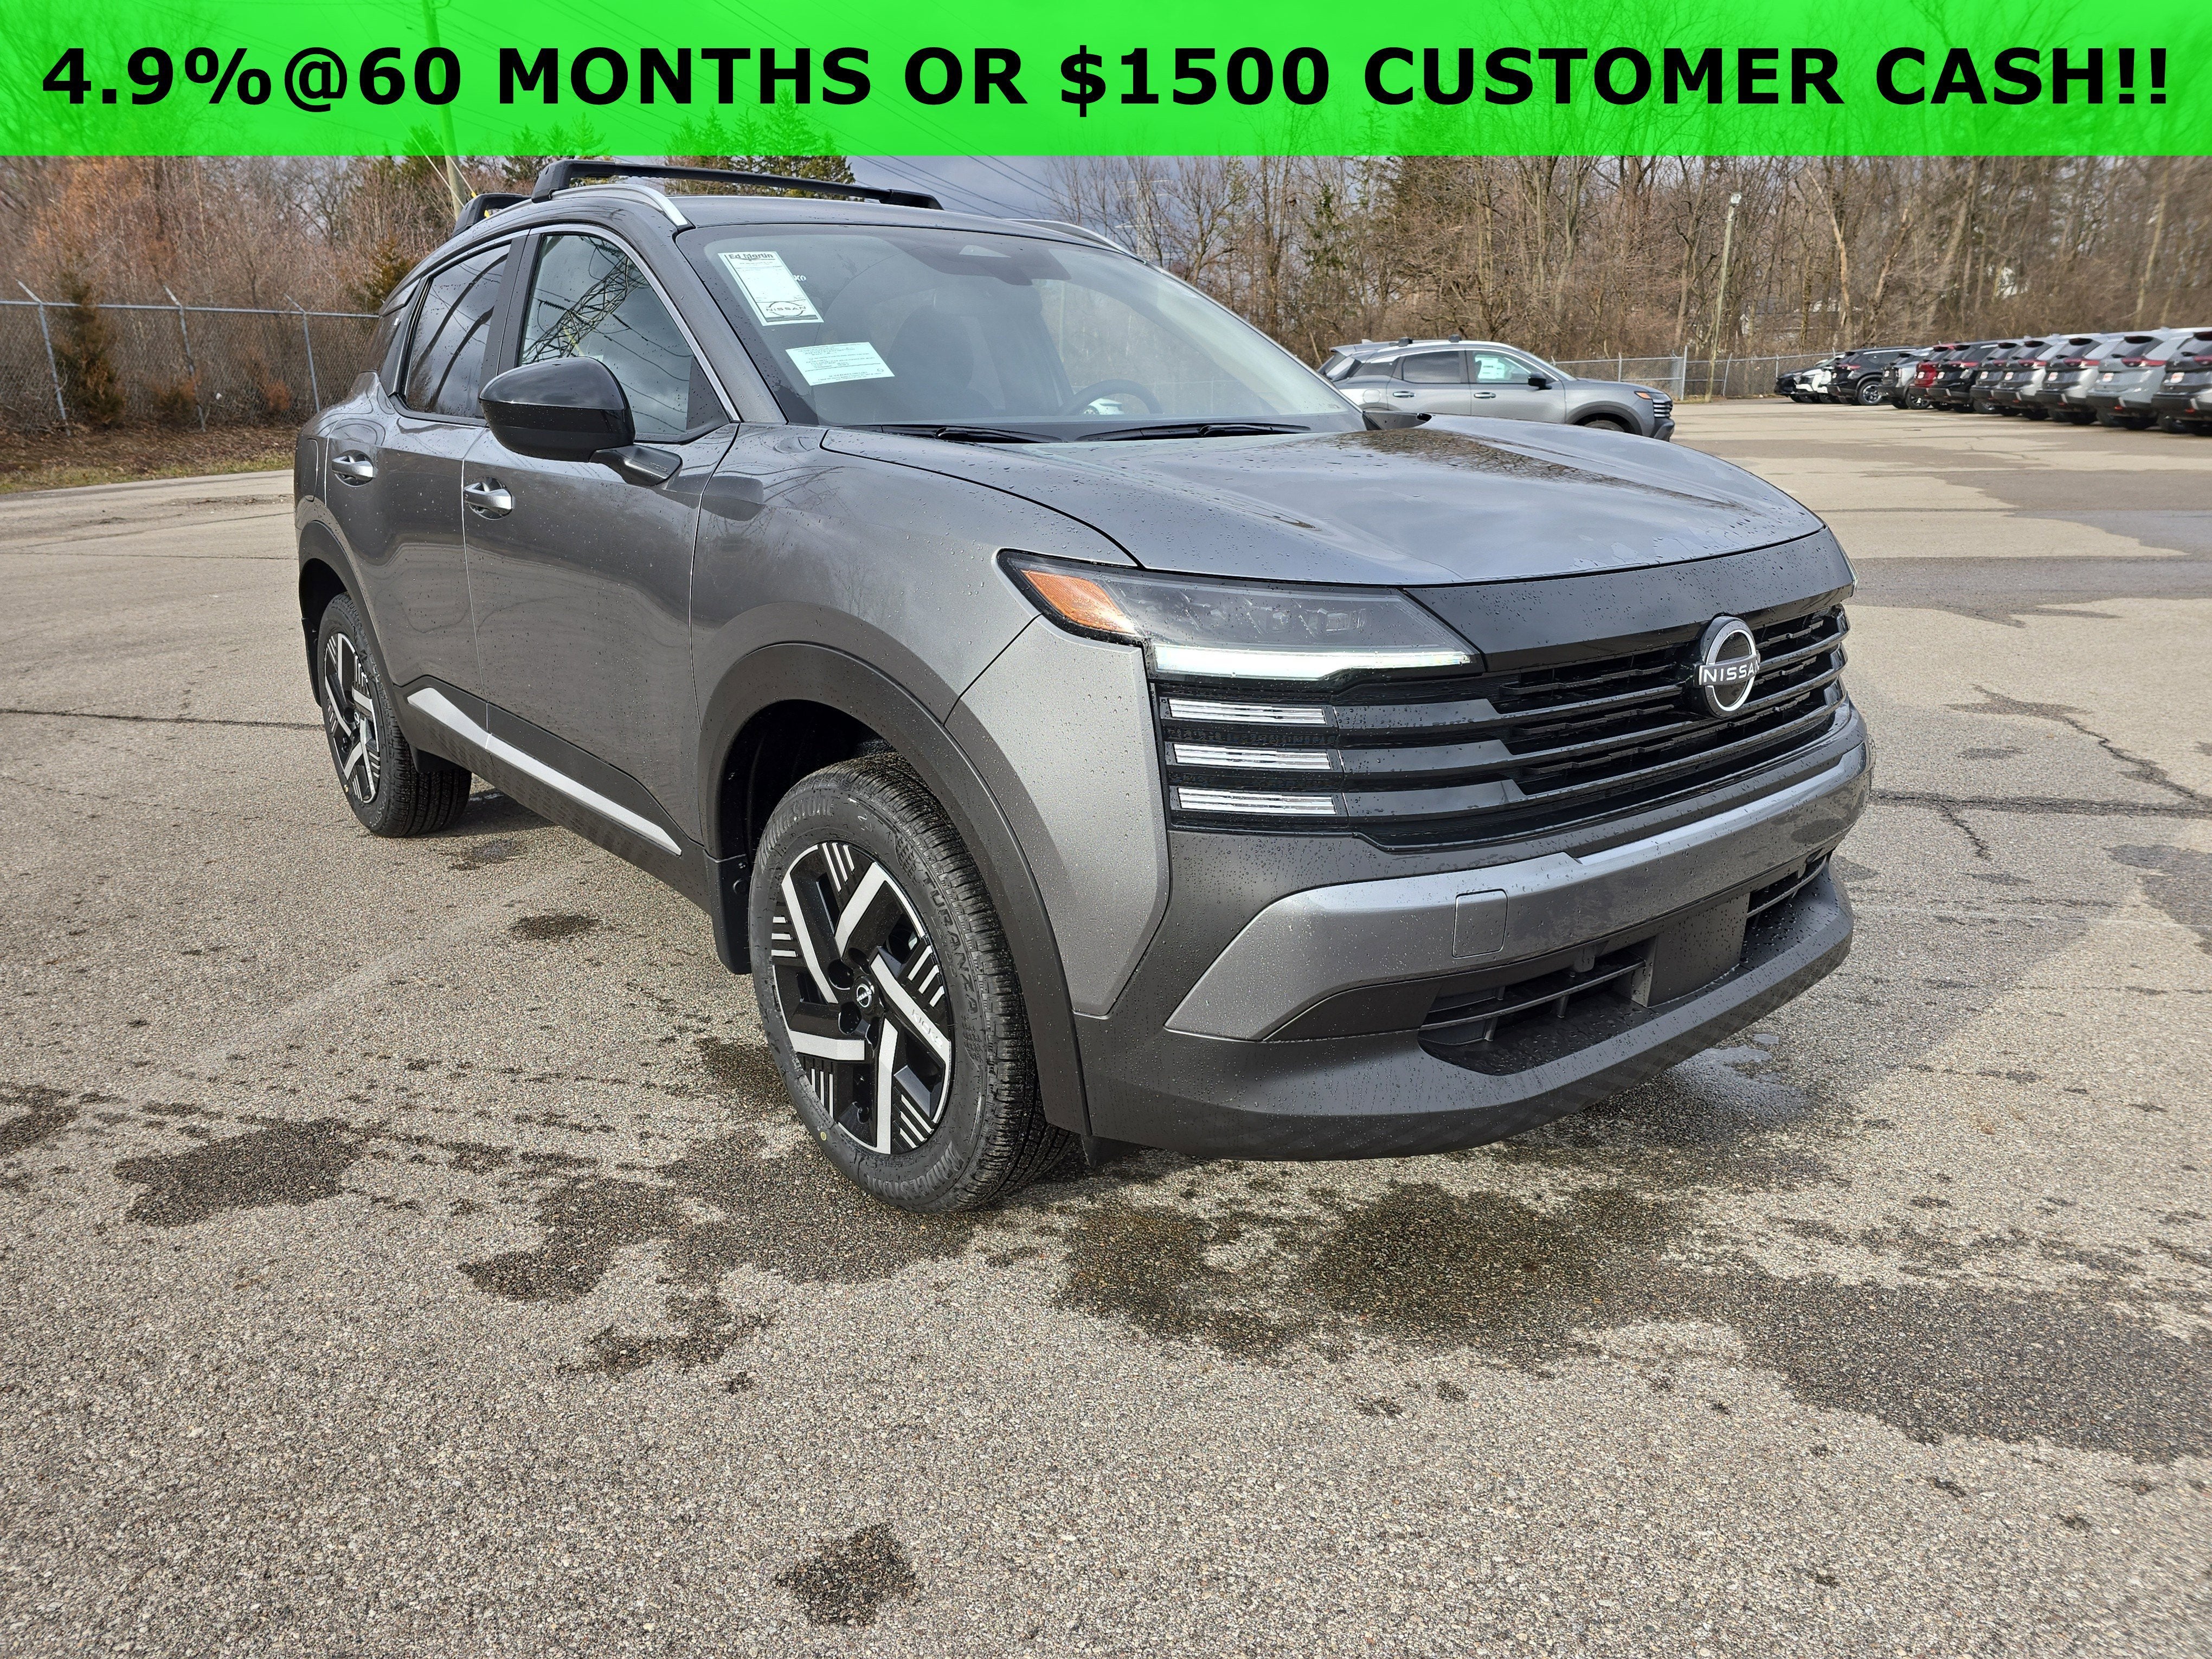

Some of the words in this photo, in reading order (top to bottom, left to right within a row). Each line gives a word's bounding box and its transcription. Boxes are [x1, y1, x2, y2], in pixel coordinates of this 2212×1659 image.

[1703, 660, 1760, 683] NISSAN
[922, 872, 978, 1014] TURANZA
[863, 1139, 964, 1201] BRIDGESTONE
